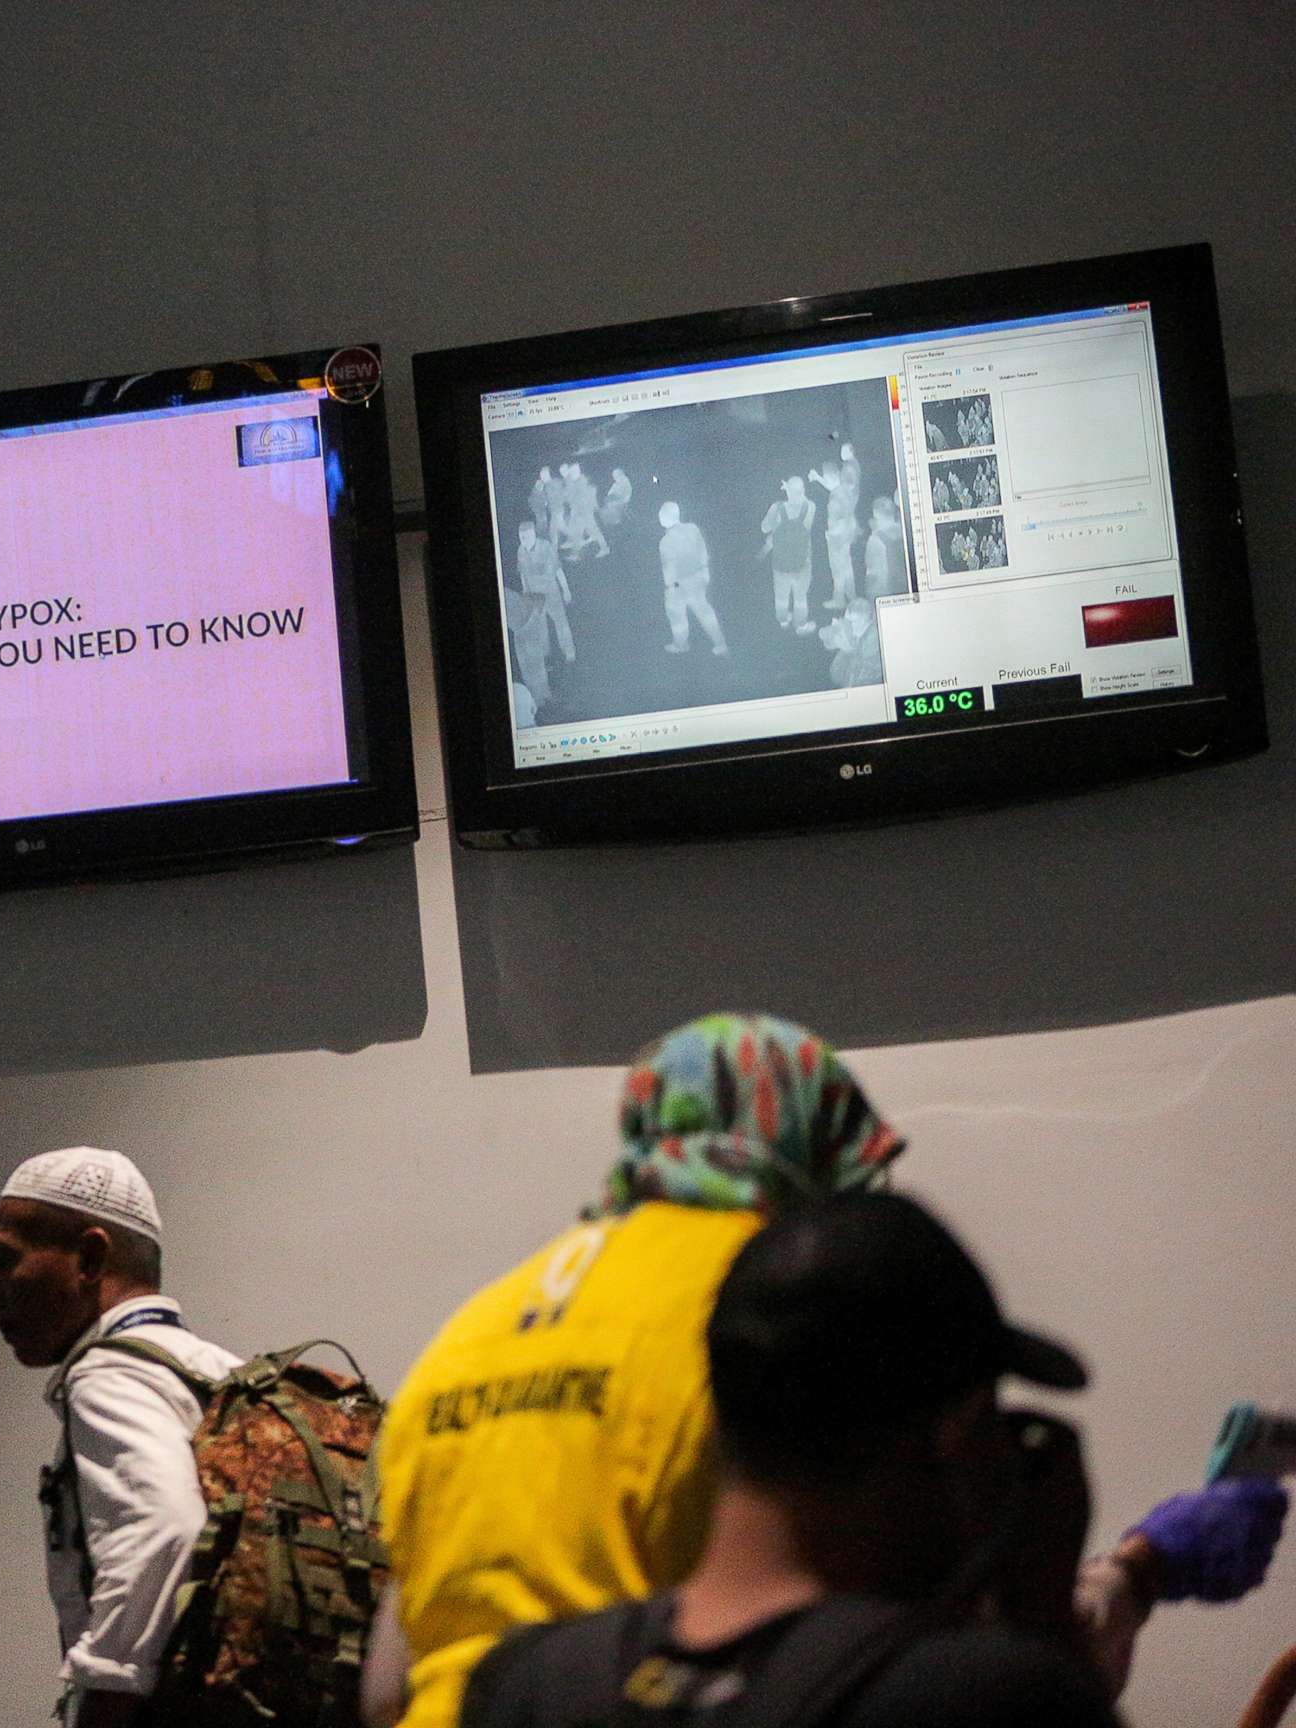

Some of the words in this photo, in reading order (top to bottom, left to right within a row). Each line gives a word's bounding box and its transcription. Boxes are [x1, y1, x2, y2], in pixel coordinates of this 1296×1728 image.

[332, 363, 374, 381] NEW
[1114, 584, 1138, 596] FAIL
[54, 627, 137, 662] NEED
[146, 621, 190, 651] TO
[200, 606, 305, 645] KNOW
[998, 665, 1047, 681] Previous
[1049, 661, 1072, 675] Fail
[916, 675, 958, 691] Current
[904, 694, 944, 717] 36.0
[949, 690, 974, 711] °C
[856, 764, 873, 776] LG
